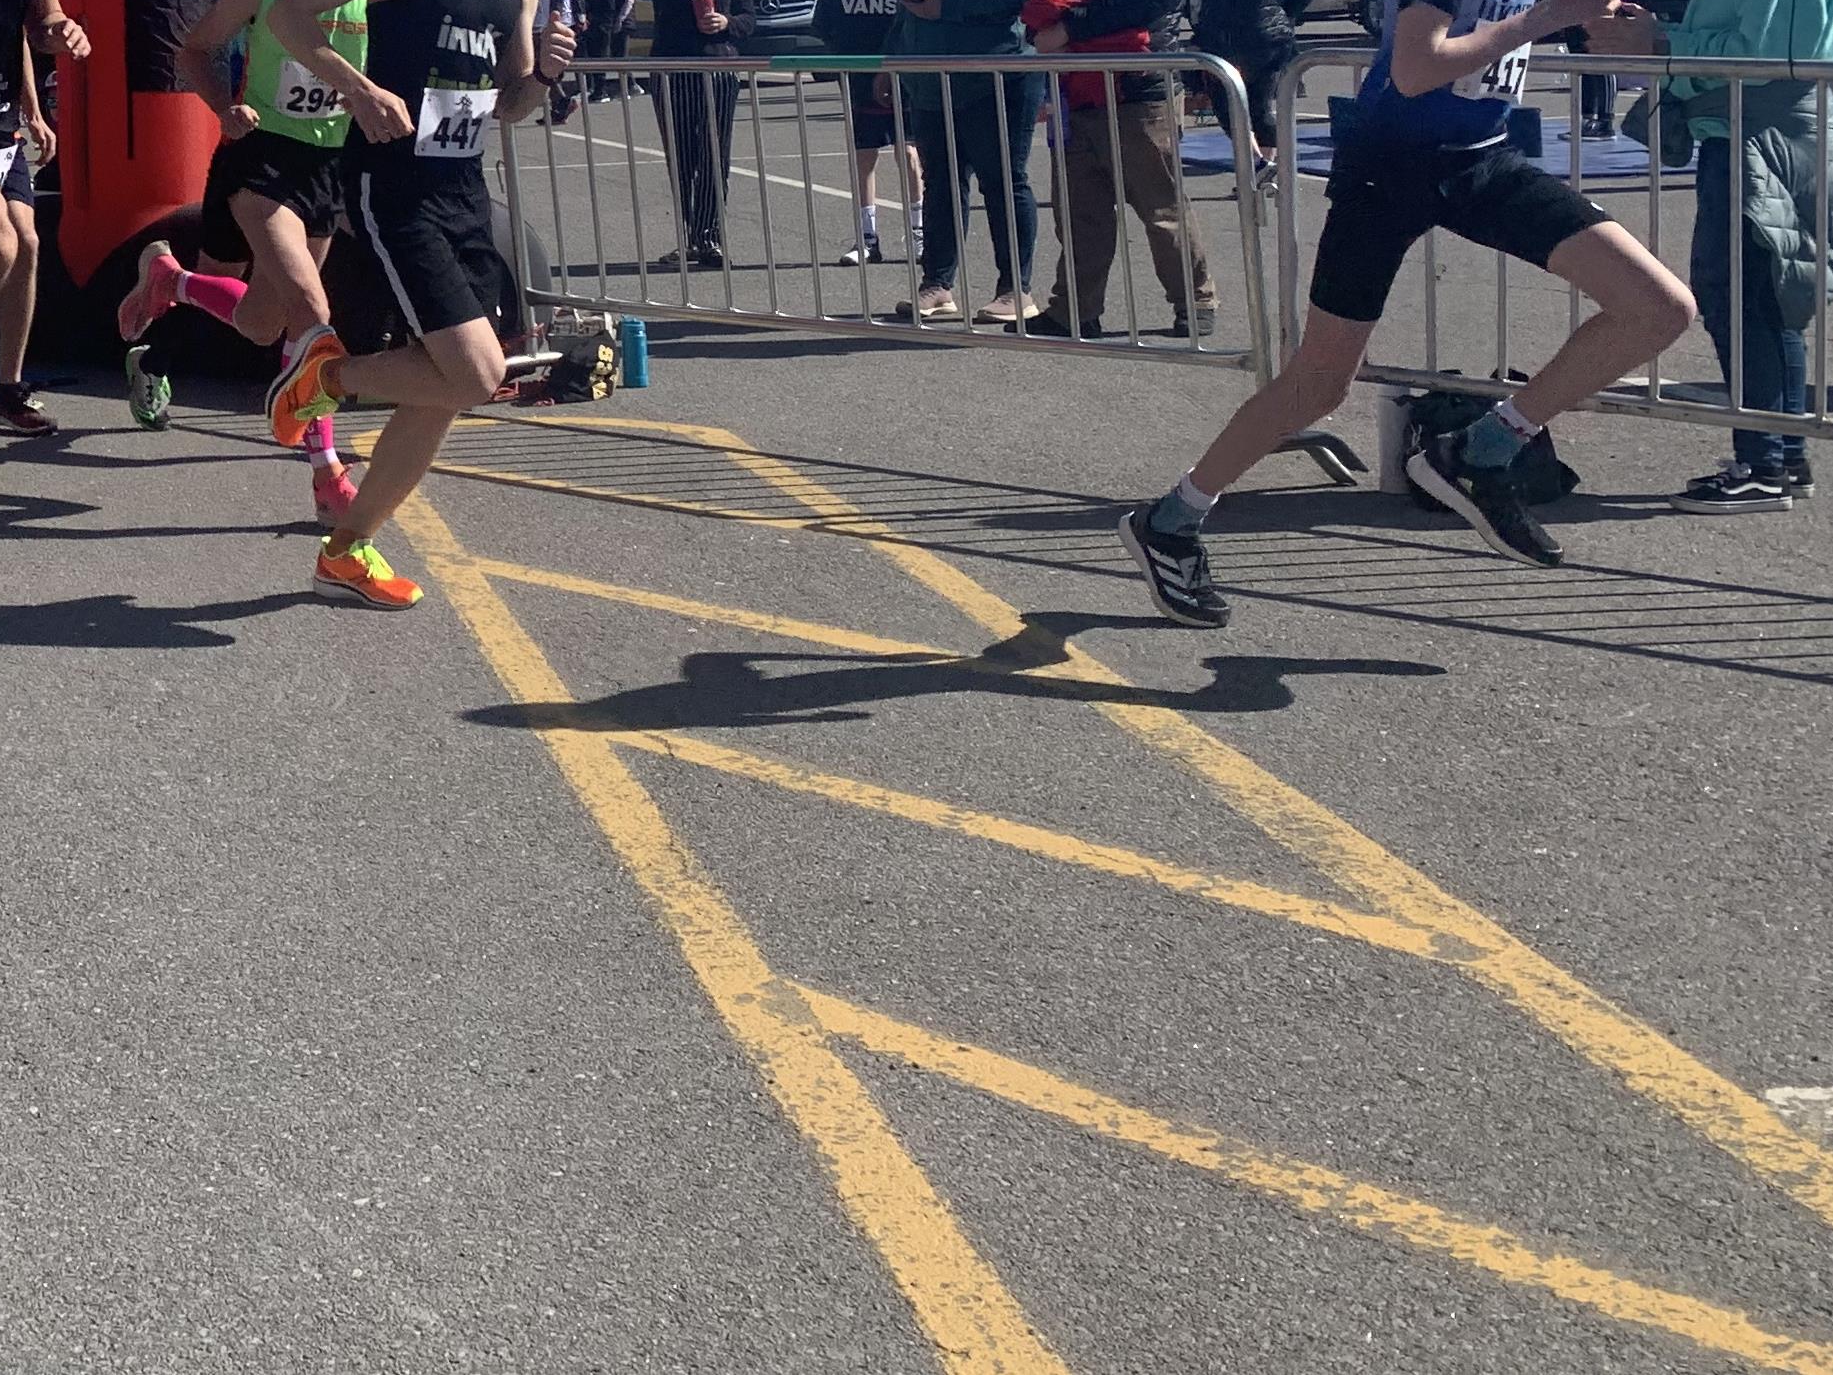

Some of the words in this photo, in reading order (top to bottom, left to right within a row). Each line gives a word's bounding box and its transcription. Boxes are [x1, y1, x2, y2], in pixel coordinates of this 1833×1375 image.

[1481, 57, 1526, 95] 417
[287, 86, 340, 112] 294
[433, 117, 483, 149] 447
